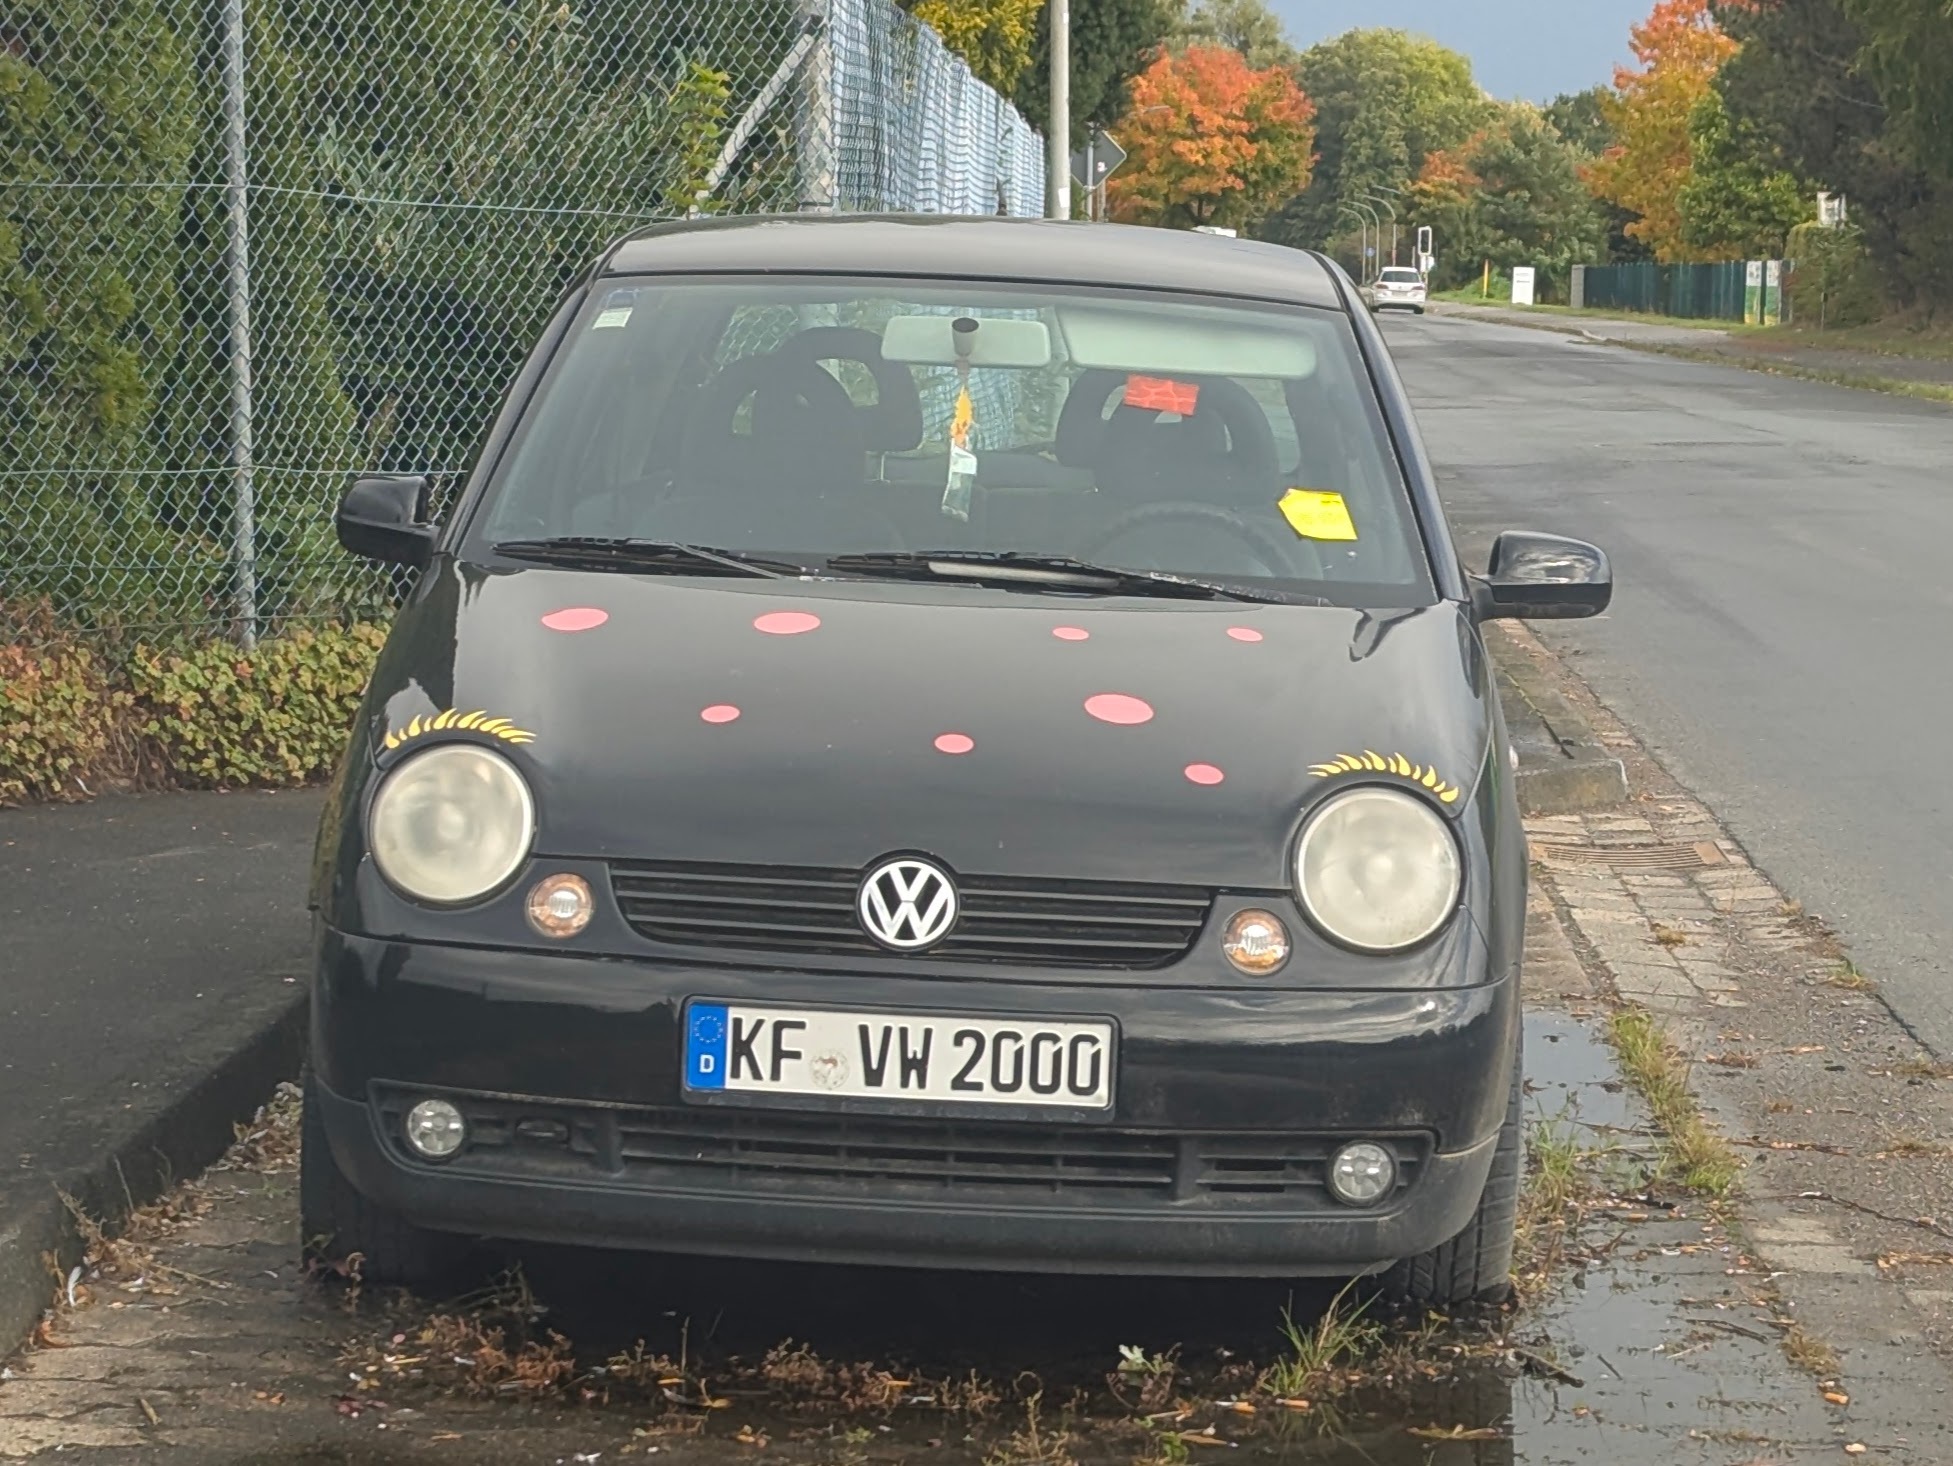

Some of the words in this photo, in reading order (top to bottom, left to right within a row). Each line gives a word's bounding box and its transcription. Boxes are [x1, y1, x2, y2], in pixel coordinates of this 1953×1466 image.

[861, 860, 956, 947] VW
[700, 1054, 715, 1073] D
[730, 1016, 806, 1082] KF
[858, 1024, 933, 1090] VW
[951, 1029, 1102, 1096] 2000
